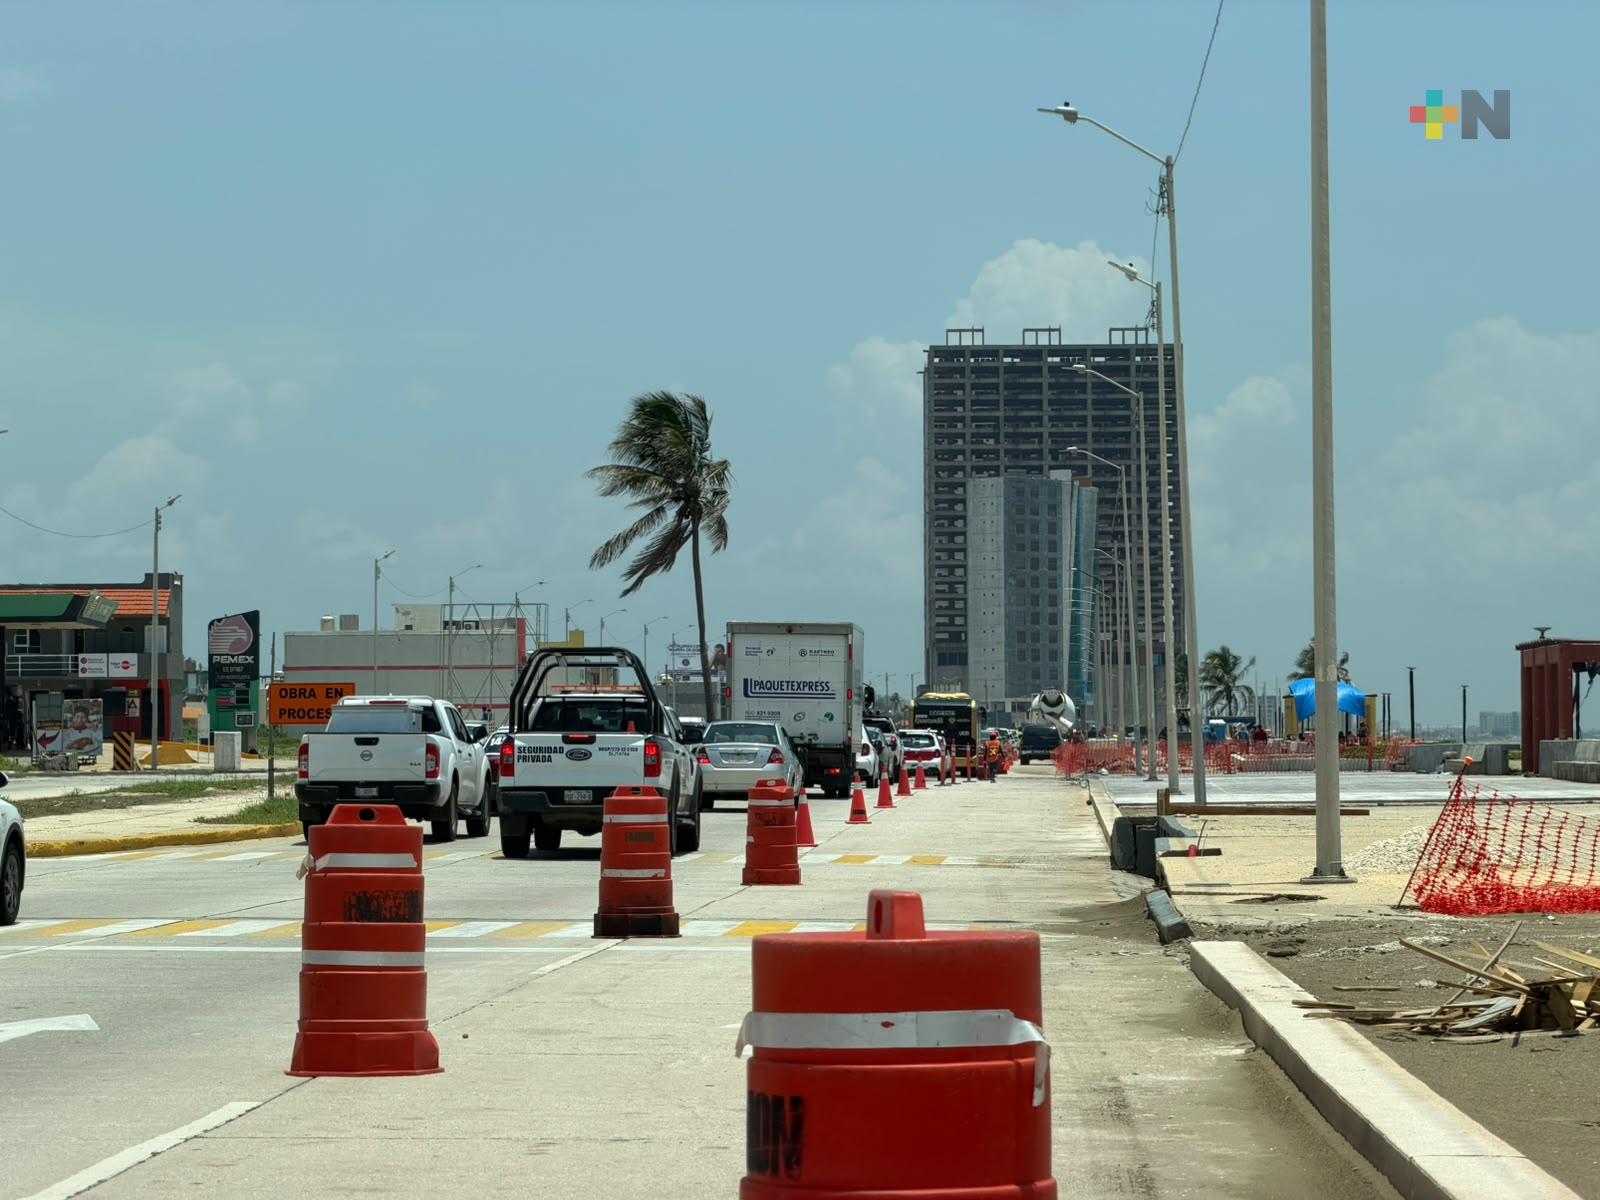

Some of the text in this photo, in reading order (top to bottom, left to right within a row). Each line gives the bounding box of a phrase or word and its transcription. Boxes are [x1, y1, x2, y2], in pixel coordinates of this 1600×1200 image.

[212, 655, 255, 664] PEMEX
[753, 680, 831, 692] PAQUETEXPRESS
[279, 688, 344, 699] OBRA EN
[279, 708, 332, 719] PROCES
[517, 746, 564, 755] SEGURIDAD
[517, 754, 552, 763] PRIVADA
